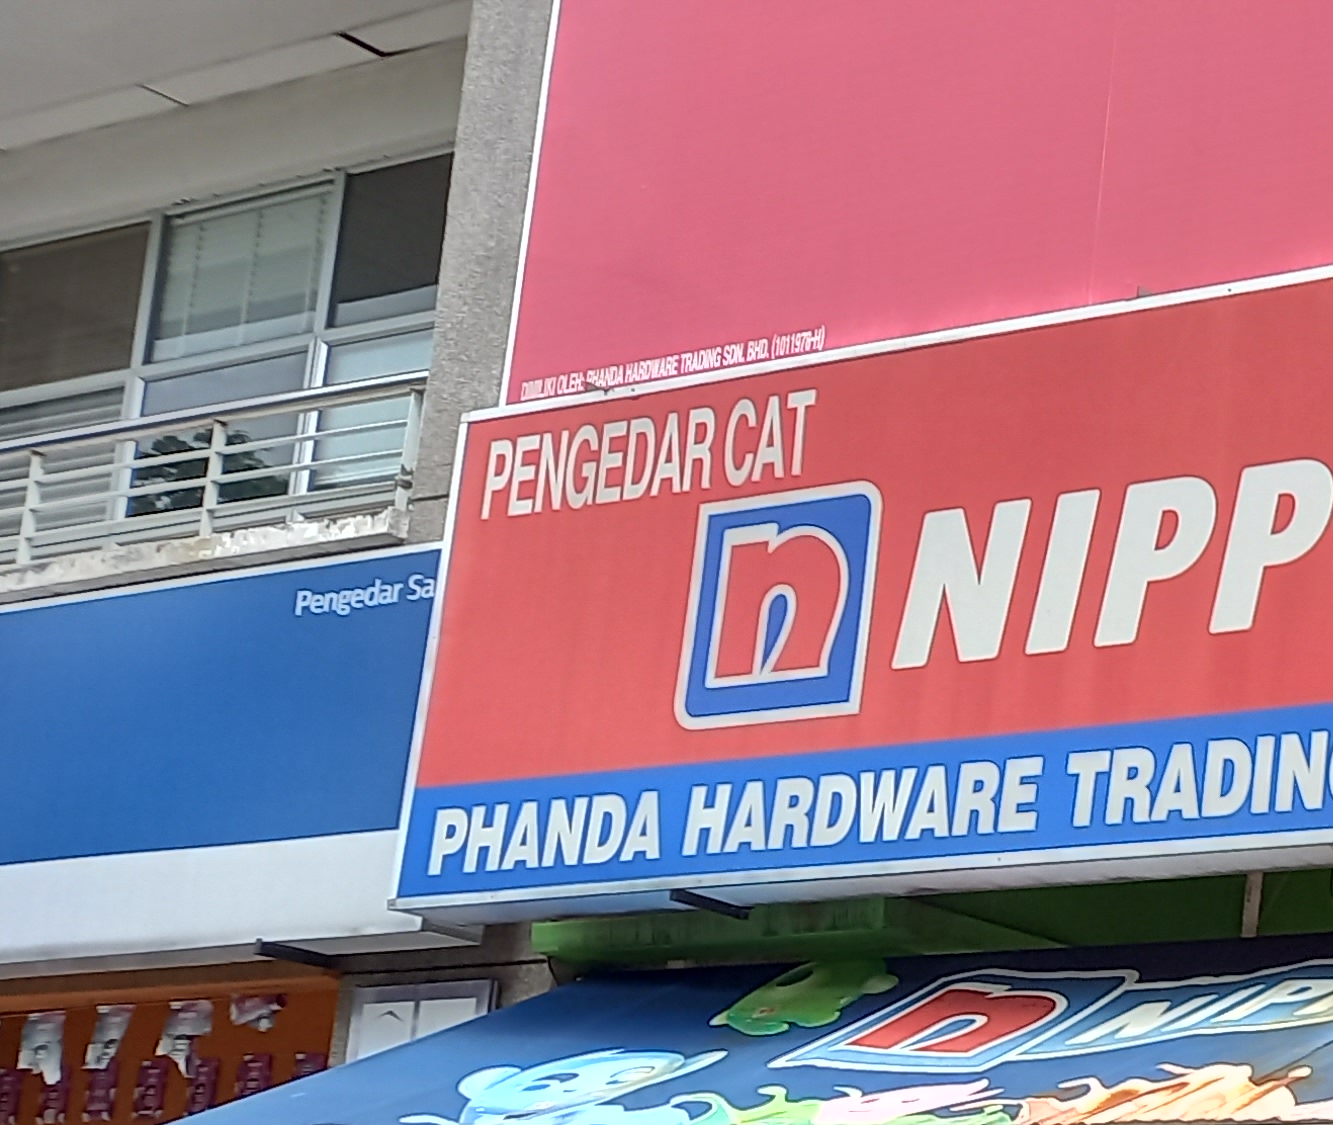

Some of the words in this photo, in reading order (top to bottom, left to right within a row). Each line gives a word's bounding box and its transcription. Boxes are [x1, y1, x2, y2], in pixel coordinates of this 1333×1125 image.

[624, 355, 680, 382] HARDWARE
[680, 345, 722, 372] TRADING
[722, 340, 746, 365] SDN.
[746, 335, 769, 361] BHD.
[479, 407, 717, 522] PENGEDAR
[723, 388, 818, 488] CAT
[294, 578, 404, 616] Pengedar
[427, 790, 661, 876] PHANDA
[681, 756, 1044, 856] HARDWARE
